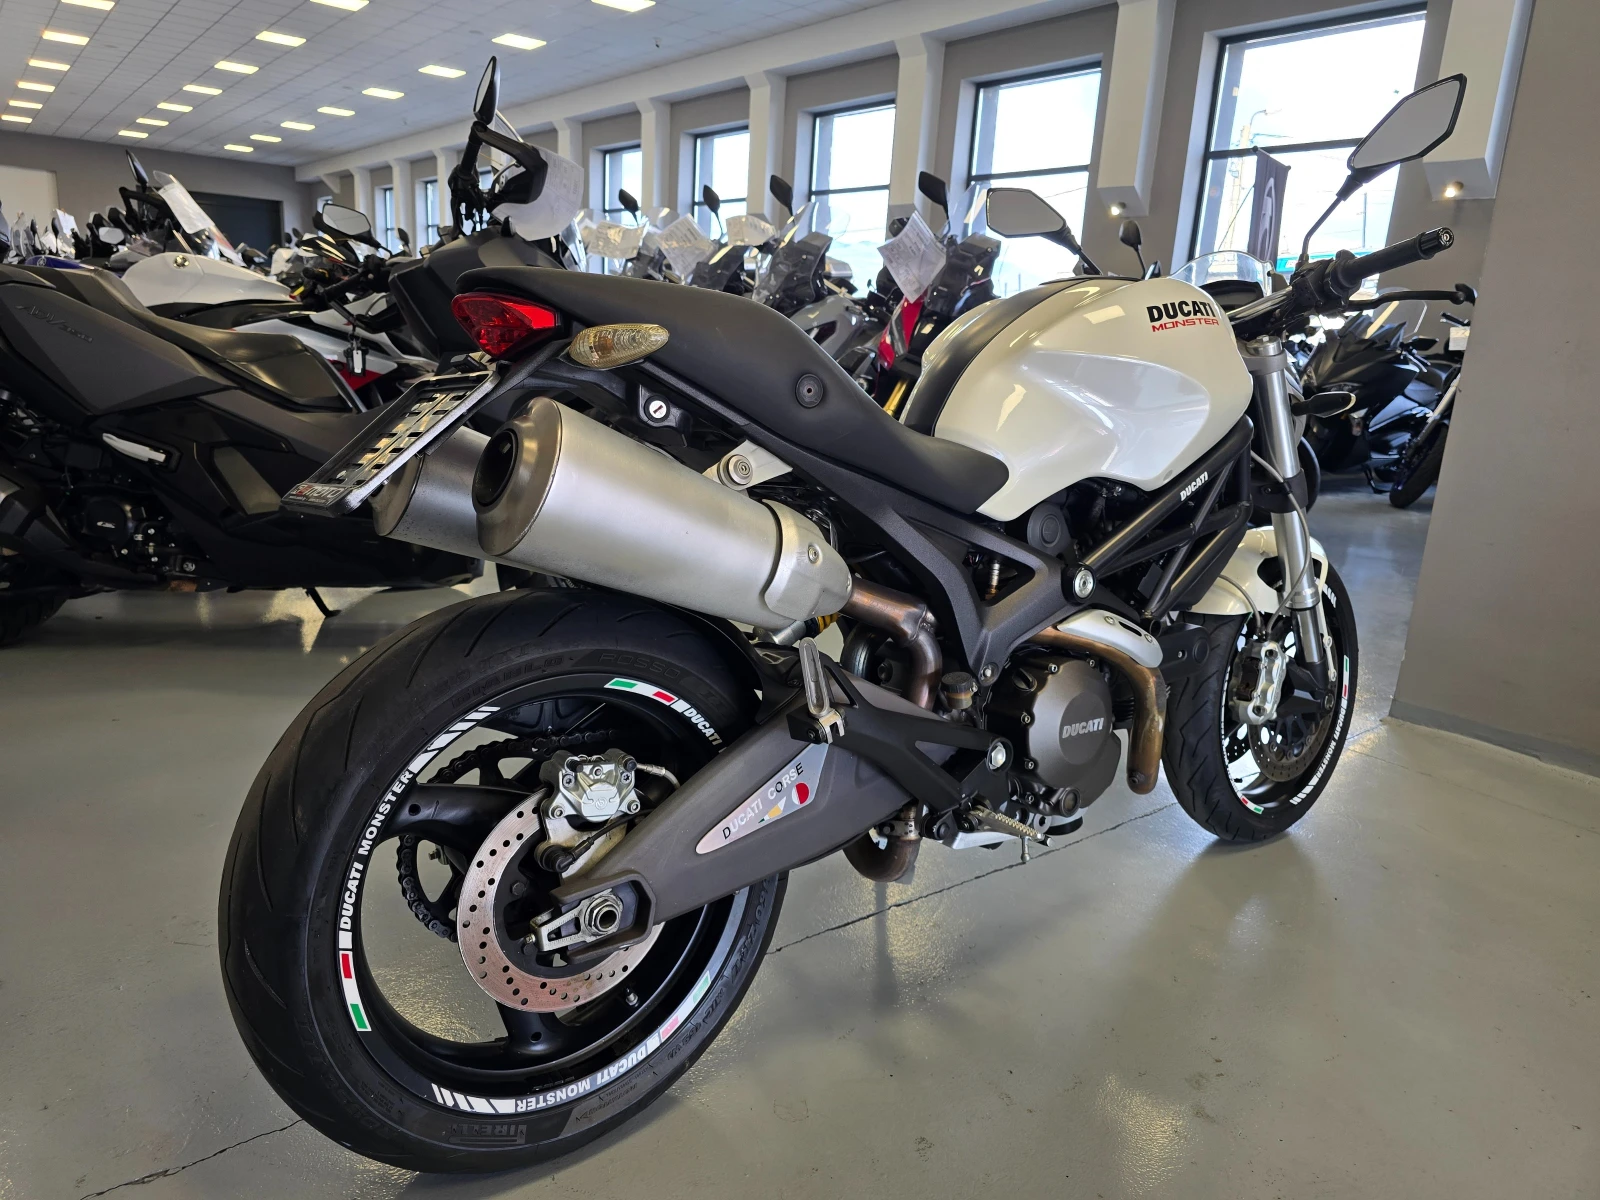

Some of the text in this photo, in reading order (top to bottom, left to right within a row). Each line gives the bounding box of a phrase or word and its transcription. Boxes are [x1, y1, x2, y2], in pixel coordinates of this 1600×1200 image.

[1146, 300, 1216, 323] DUCATI
[1151, 317, 1220, 333] MONSTER
[1179, 471, 1209, 502] DUCATI
[597, 653, 681, 679] ROSSO
[683, 707, 723, 746] DUCATI
[1062, 717, 1105, 739] DUCATI
[1316, 706, 1347, 779] DUCATI MONSTER
[722, 762, 804, 840] DUCATI CORSE
[339, 771, 414, 931] DUCATI MONSTER
[595, 1046, 649, 1085] DUCATI
[516, 1078, 591, 1112] MONSTER
[448, 1124, 528, 1145] PIRELLI
